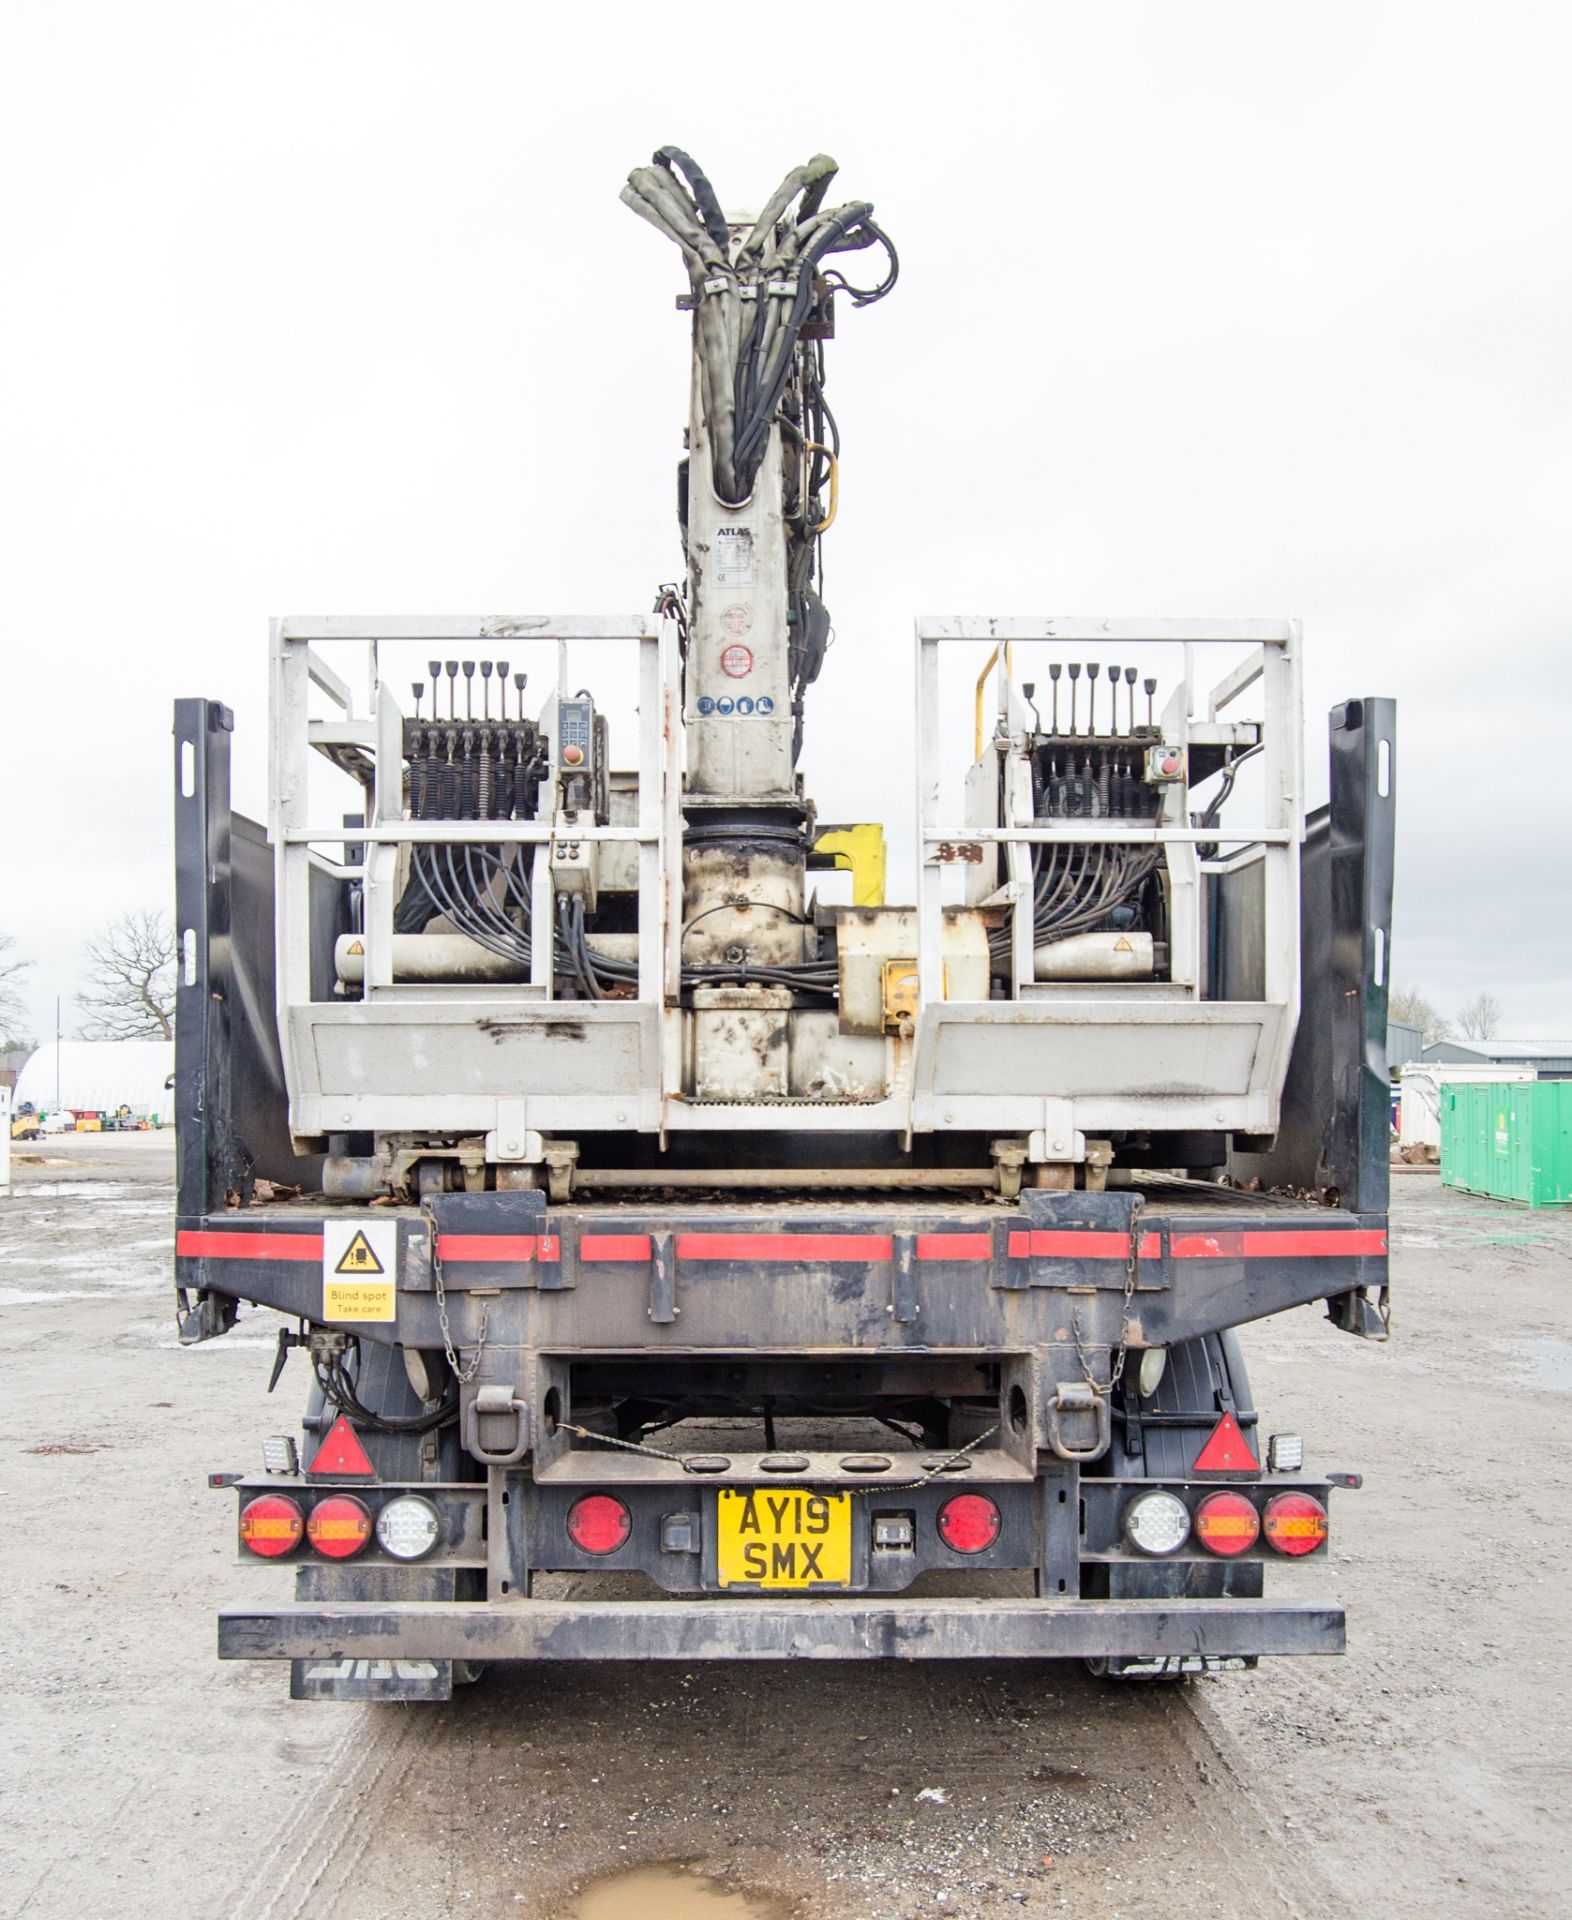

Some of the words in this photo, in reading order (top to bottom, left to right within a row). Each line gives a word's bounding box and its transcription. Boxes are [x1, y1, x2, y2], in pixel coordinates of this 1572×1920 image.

[718, 528, 751, 536] ATLAS
[331, 1290, 358, 1300] Blind
[362, 1292, 386, 1302] spot
[337, 1304, 358, 1313] Take
[739, 1496, 830, 1534] AY19
[744, 1542, 824, 1579] SMX
